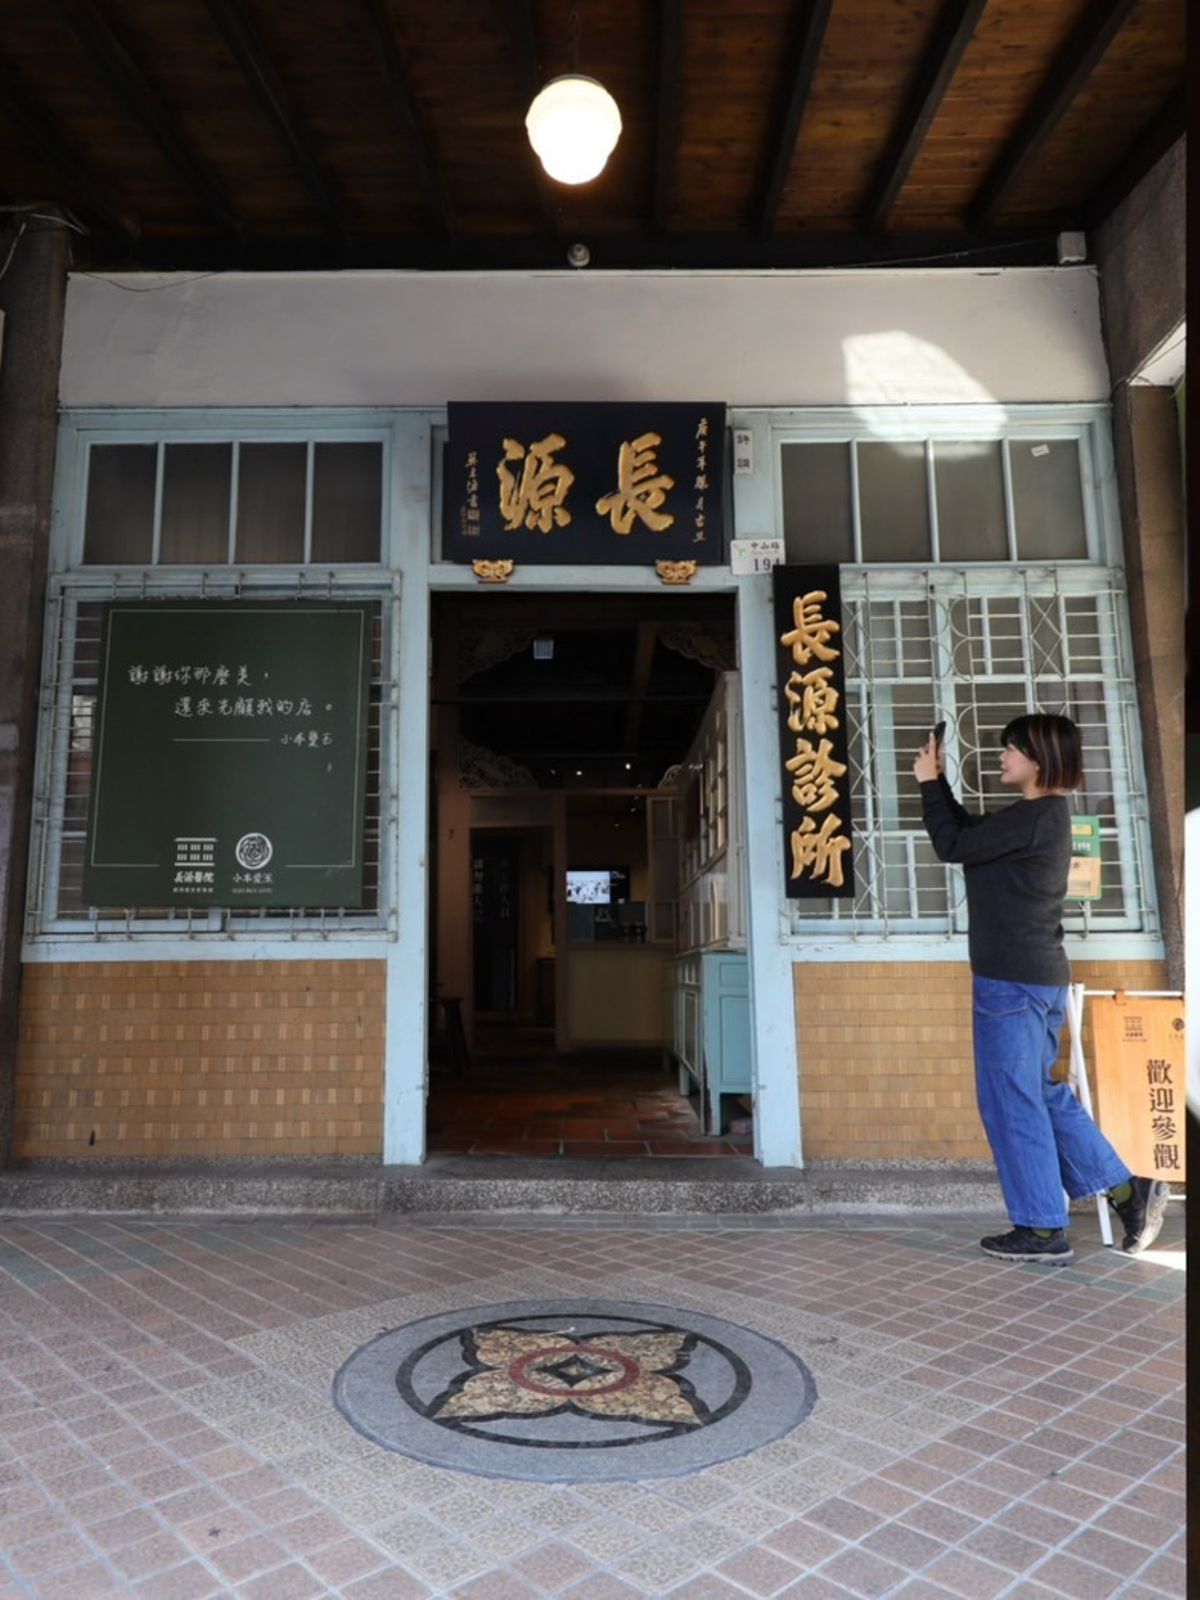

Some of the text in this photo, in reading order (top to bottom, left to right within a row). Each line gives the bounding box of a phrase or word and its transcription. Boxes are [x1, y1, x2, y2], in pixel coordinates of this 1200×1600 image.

[496, 431, 675, 535] 長源
[751, 541, 780, 550] 中山路
[780, 590, 851, 887] 長源診所
[1146, 1059, 1181, 1171] 歡迎參觀
